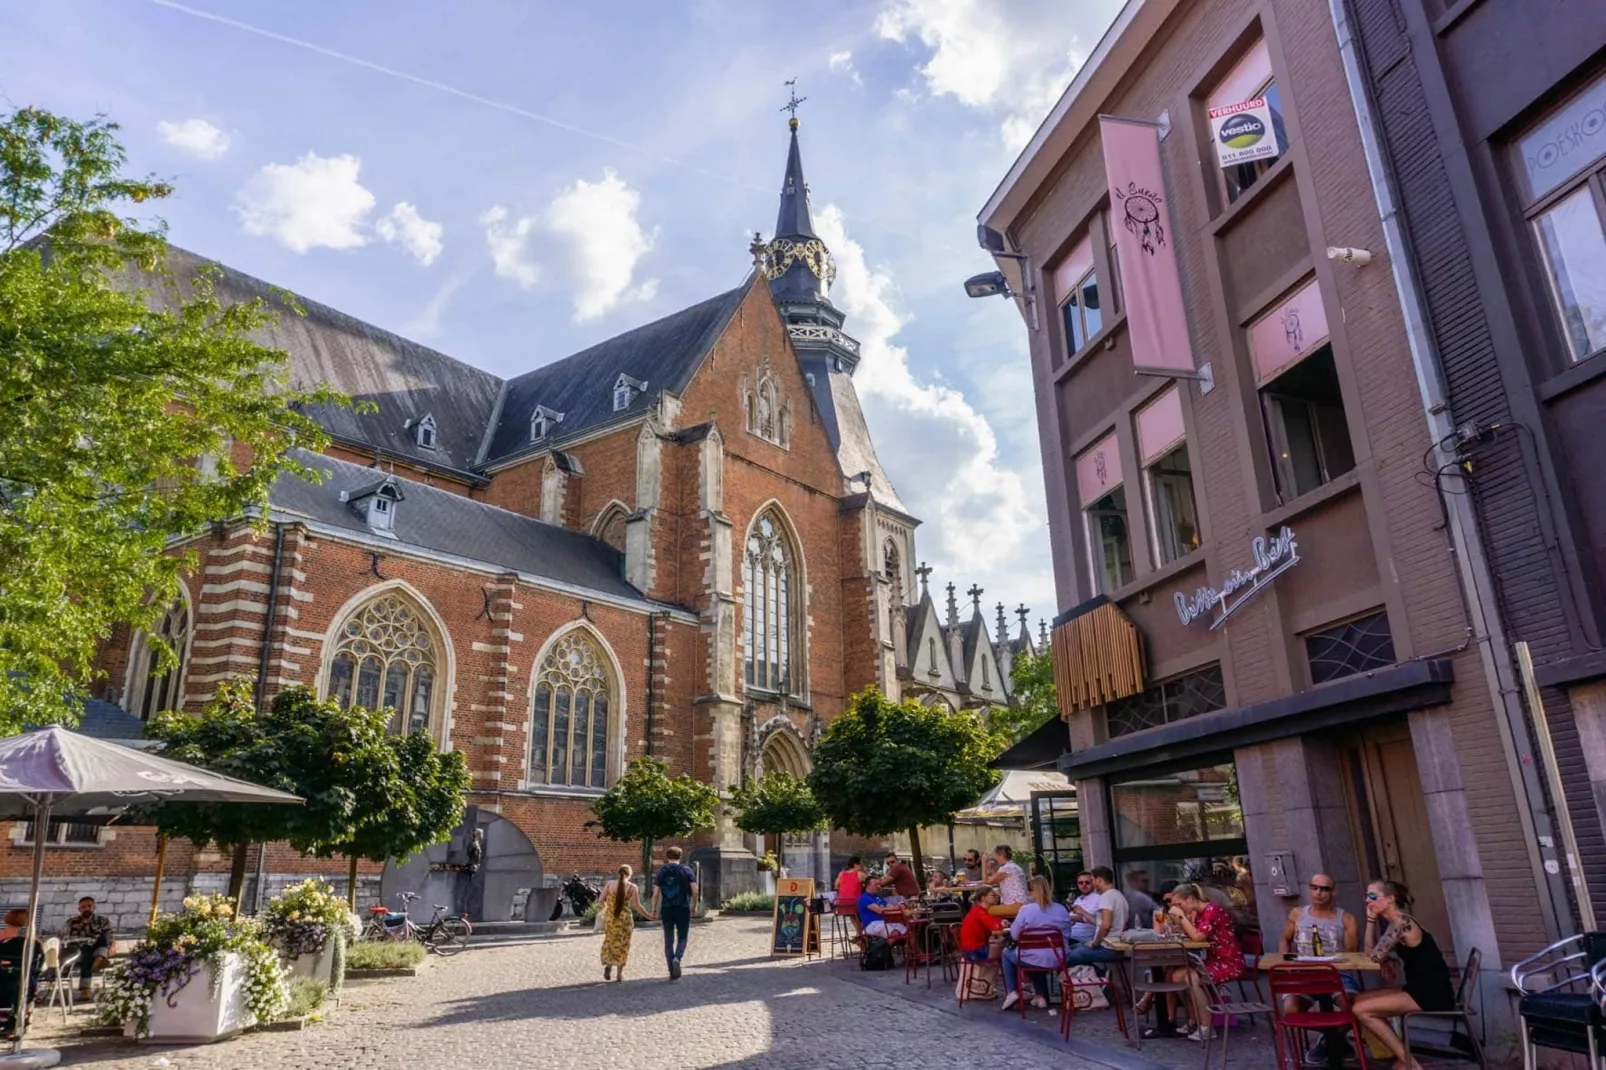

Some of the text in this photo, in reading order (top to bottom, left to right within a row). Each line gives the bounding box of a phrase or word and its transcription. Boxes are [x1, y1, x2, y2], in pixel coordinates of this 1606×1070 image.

[1210, 99, 1263, 117] VERHUURD
[1221, 122, 1261, 137] vestio
[1527, 101, 1606, 177] POESKO
